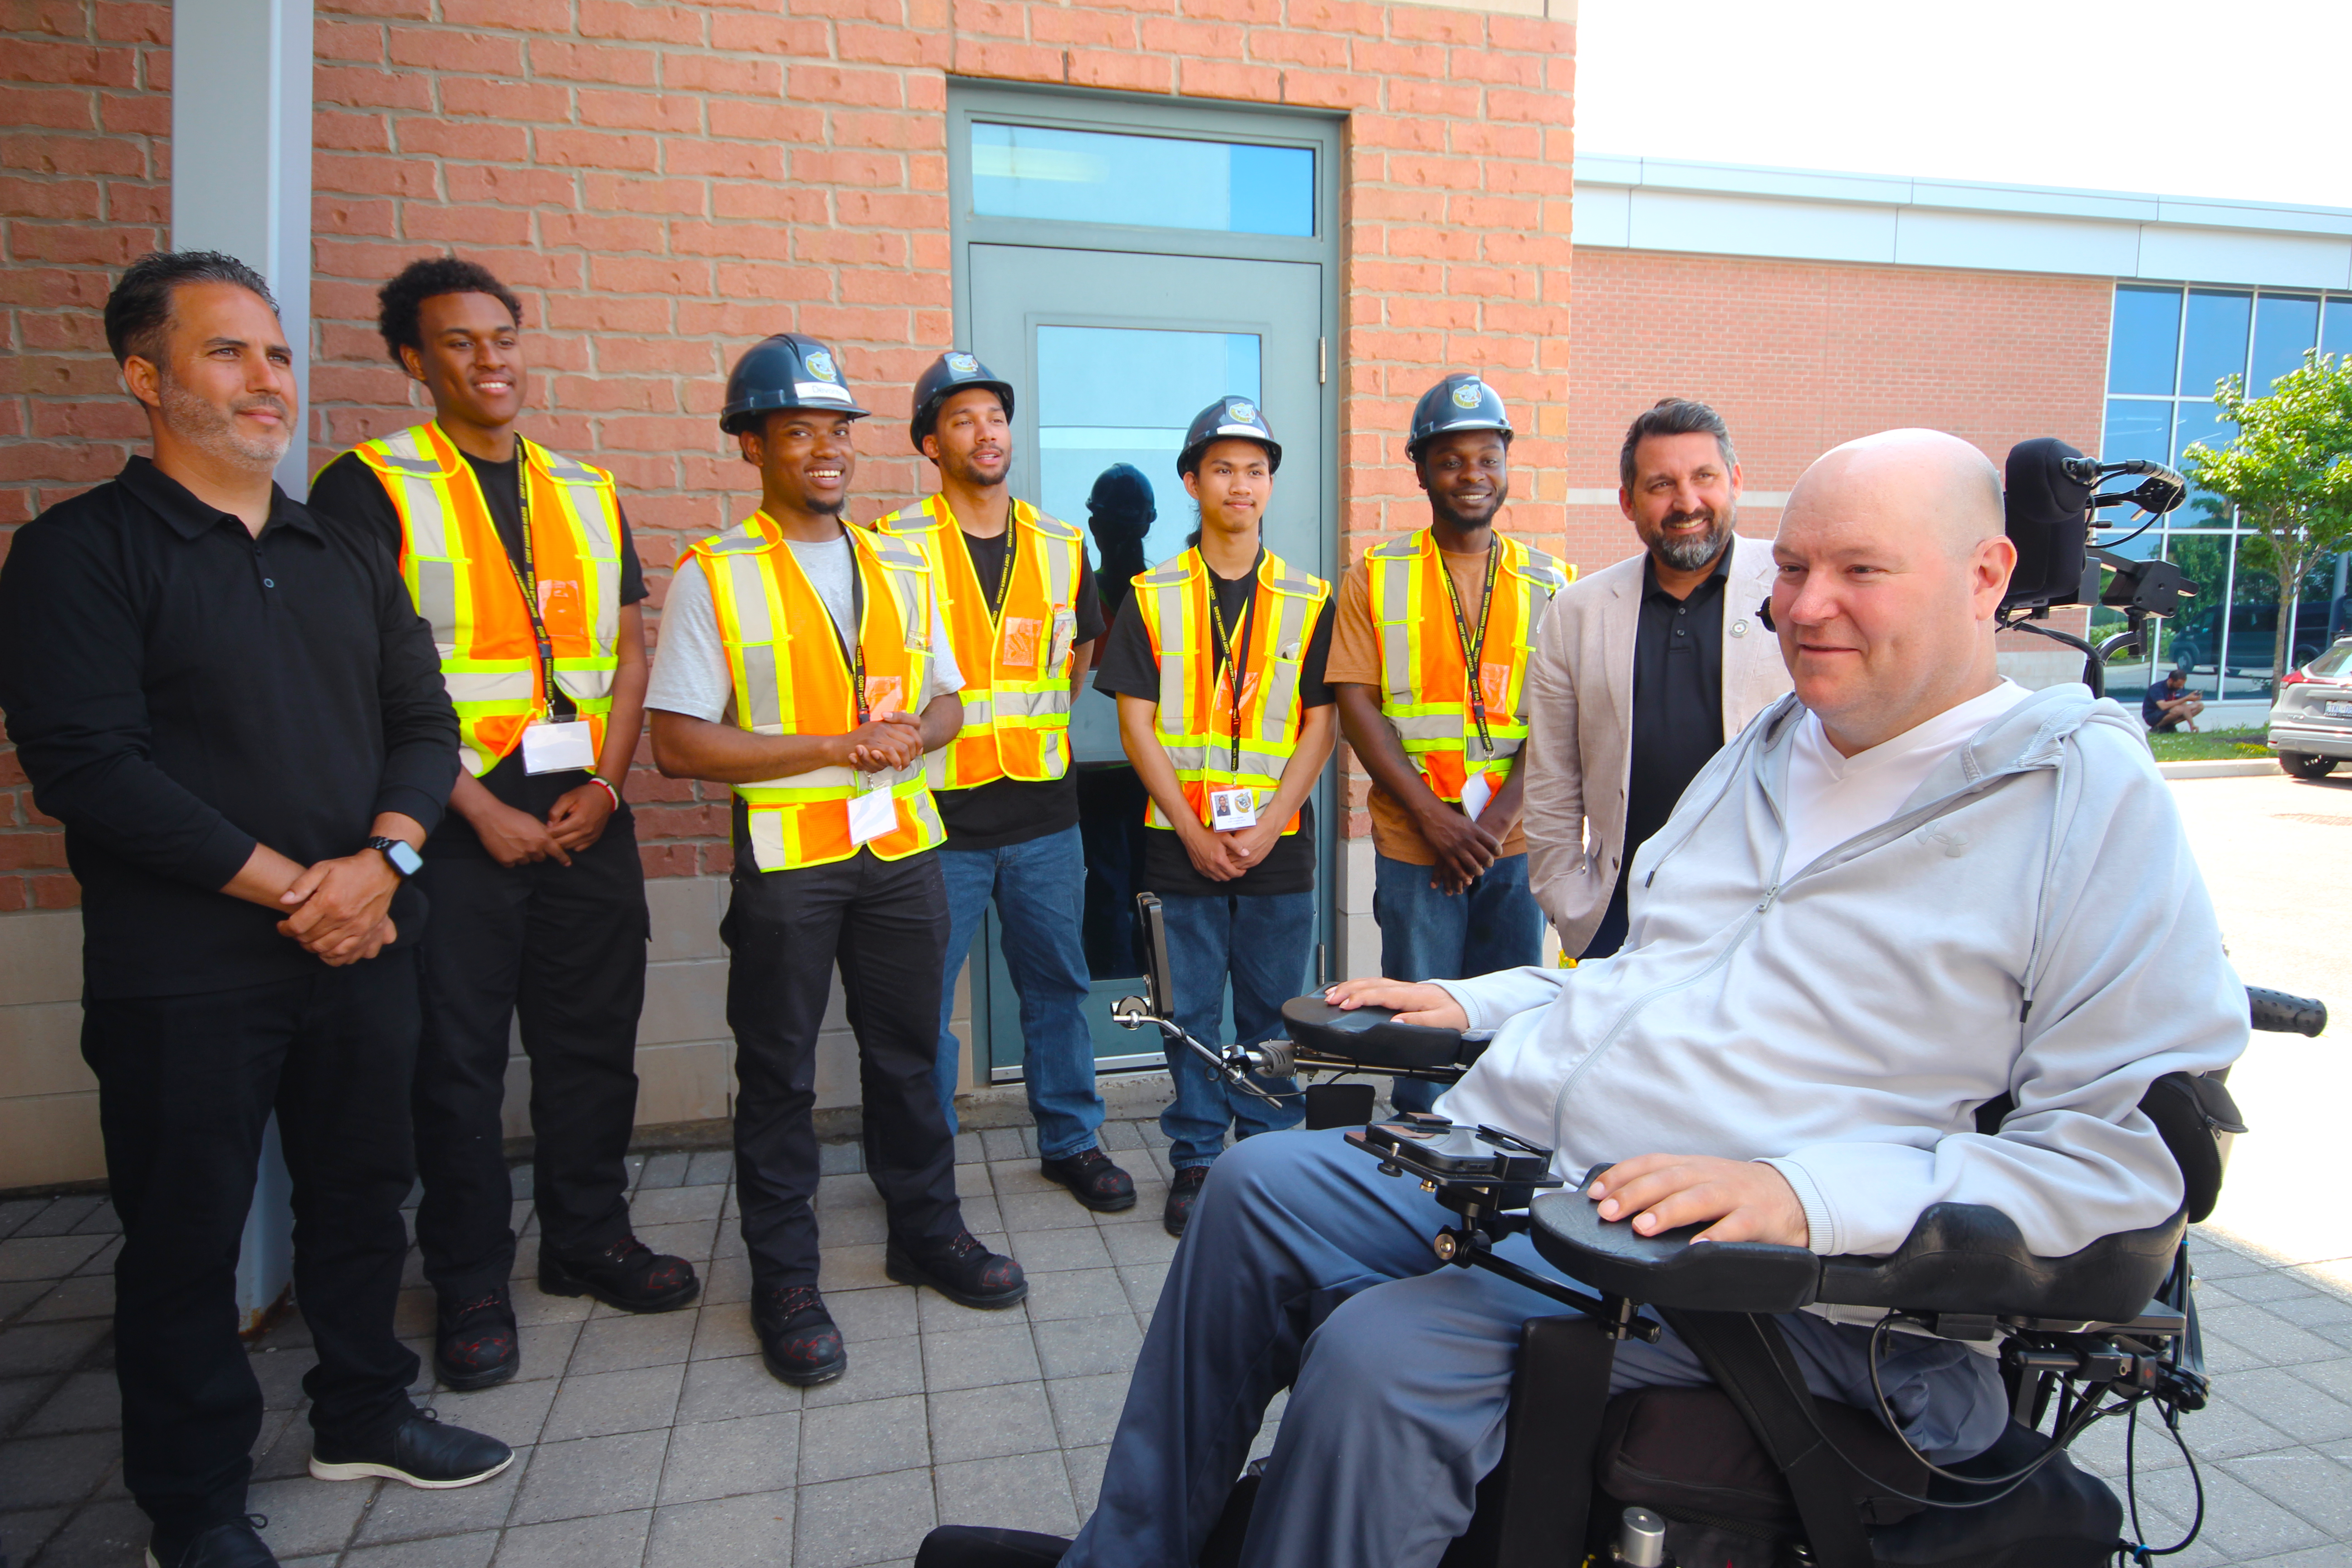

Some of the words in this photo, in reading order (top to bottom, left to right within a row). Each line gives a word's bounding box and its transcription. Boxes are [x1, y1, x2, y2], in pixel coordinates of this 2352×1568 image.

[996, 587, 1004, 604] HEADS
[1447, 580, 1457, 600] HAMMER
[1214, 606, 1222, 622] HEADS
[1480, 606, 1488, 627] HAMMER
[1217, 622, 1228, 643] HAMMER
[1461, 634, 1471, 655] HAMMER
[1466, 655, 1475, 672] HEADS
